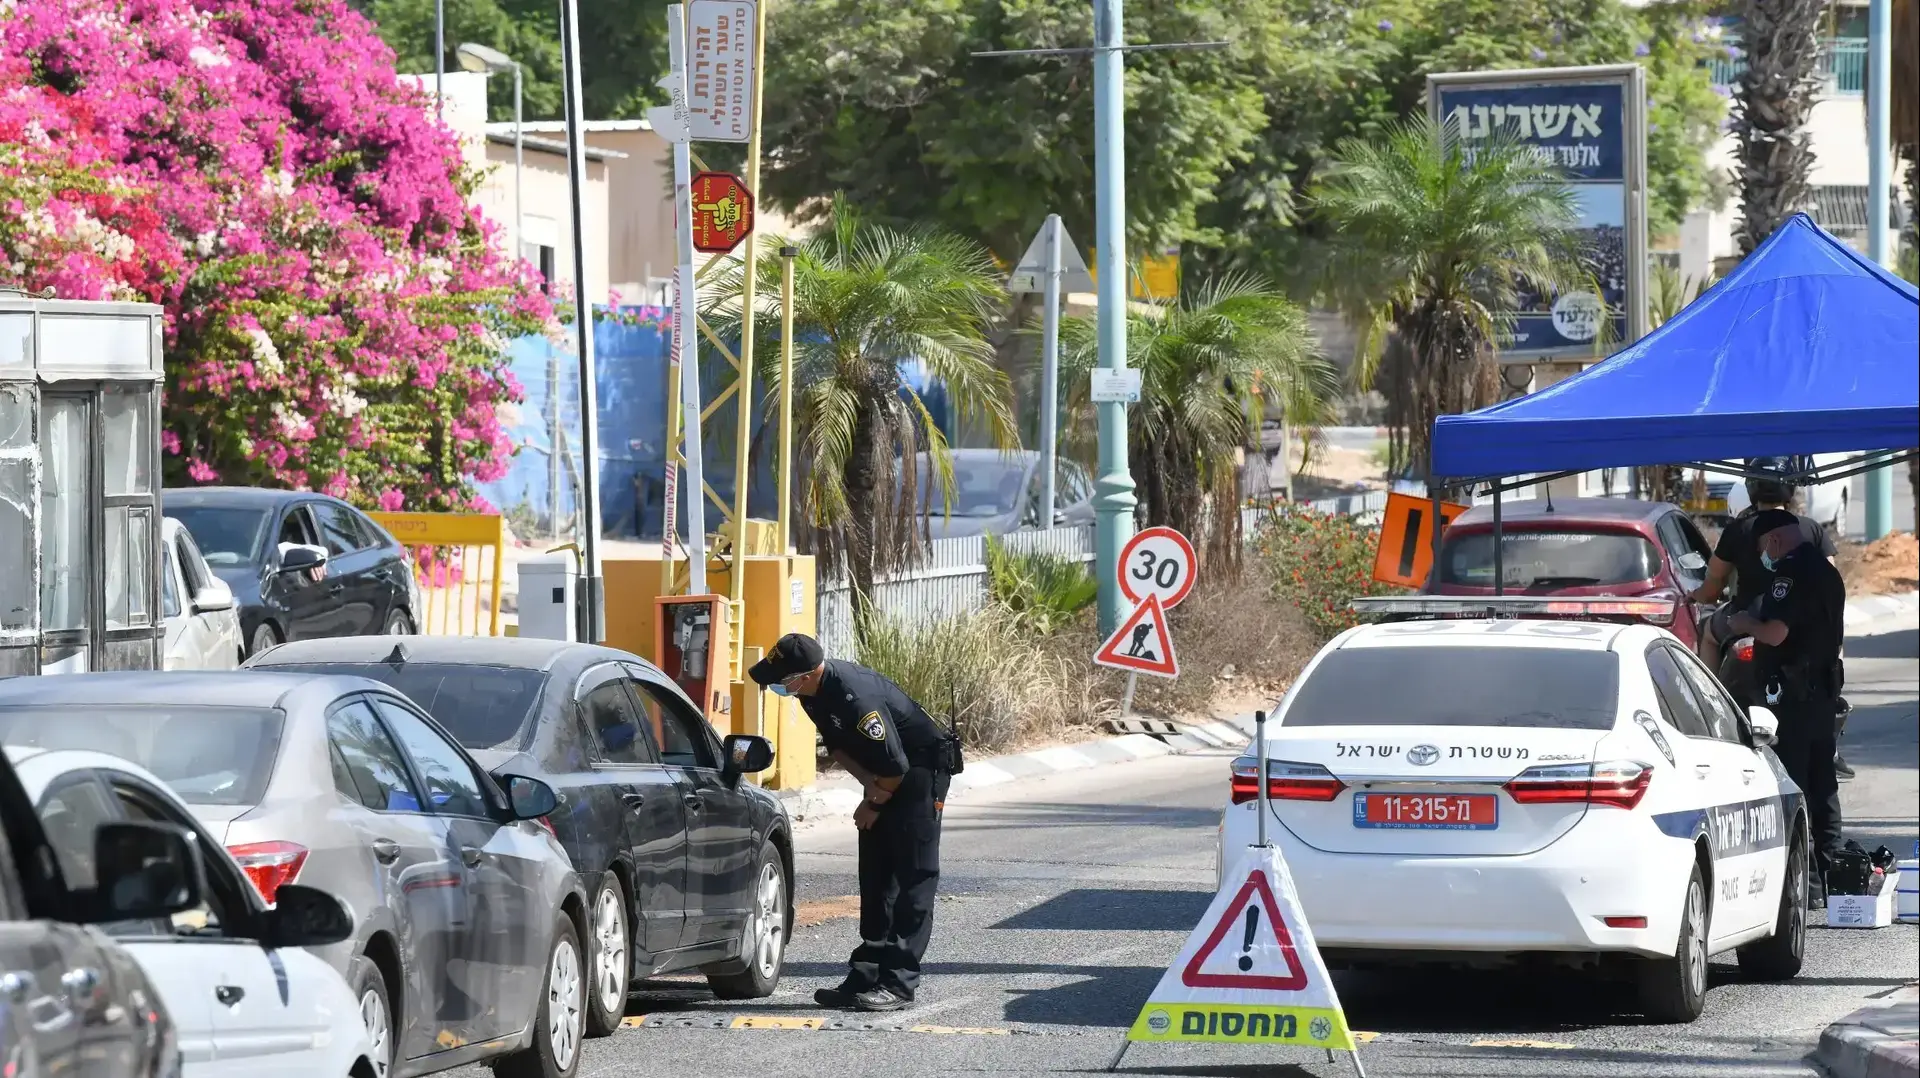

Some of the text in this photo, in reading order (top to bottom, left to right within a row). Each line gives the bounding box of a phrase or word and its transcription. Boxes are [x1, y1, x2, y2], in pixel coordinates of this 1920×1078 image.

[694, 26, 711, 99] זהירות
[710, 15, 729, 125] שער חשמלי
[732, 8, 745, 134] סגירה אוטומטית
[1455, 103, 1602, 139] אשרינו
[1558, 143, 1600, 168] אלעד
[1501, 533, 1592, 542] ww.amit-pastry.com
[1132, 549, 1179, 589] 30
[1336, 742, 1529, 759] משטרת ישראל
[1356, 804, 1364, 814] IL
[1715, 804, 1776, 851] משטרת ישראל
[1721, 876, 1739, 902] POLICE
[1181, 1011, 1297, 1038] מחסום
